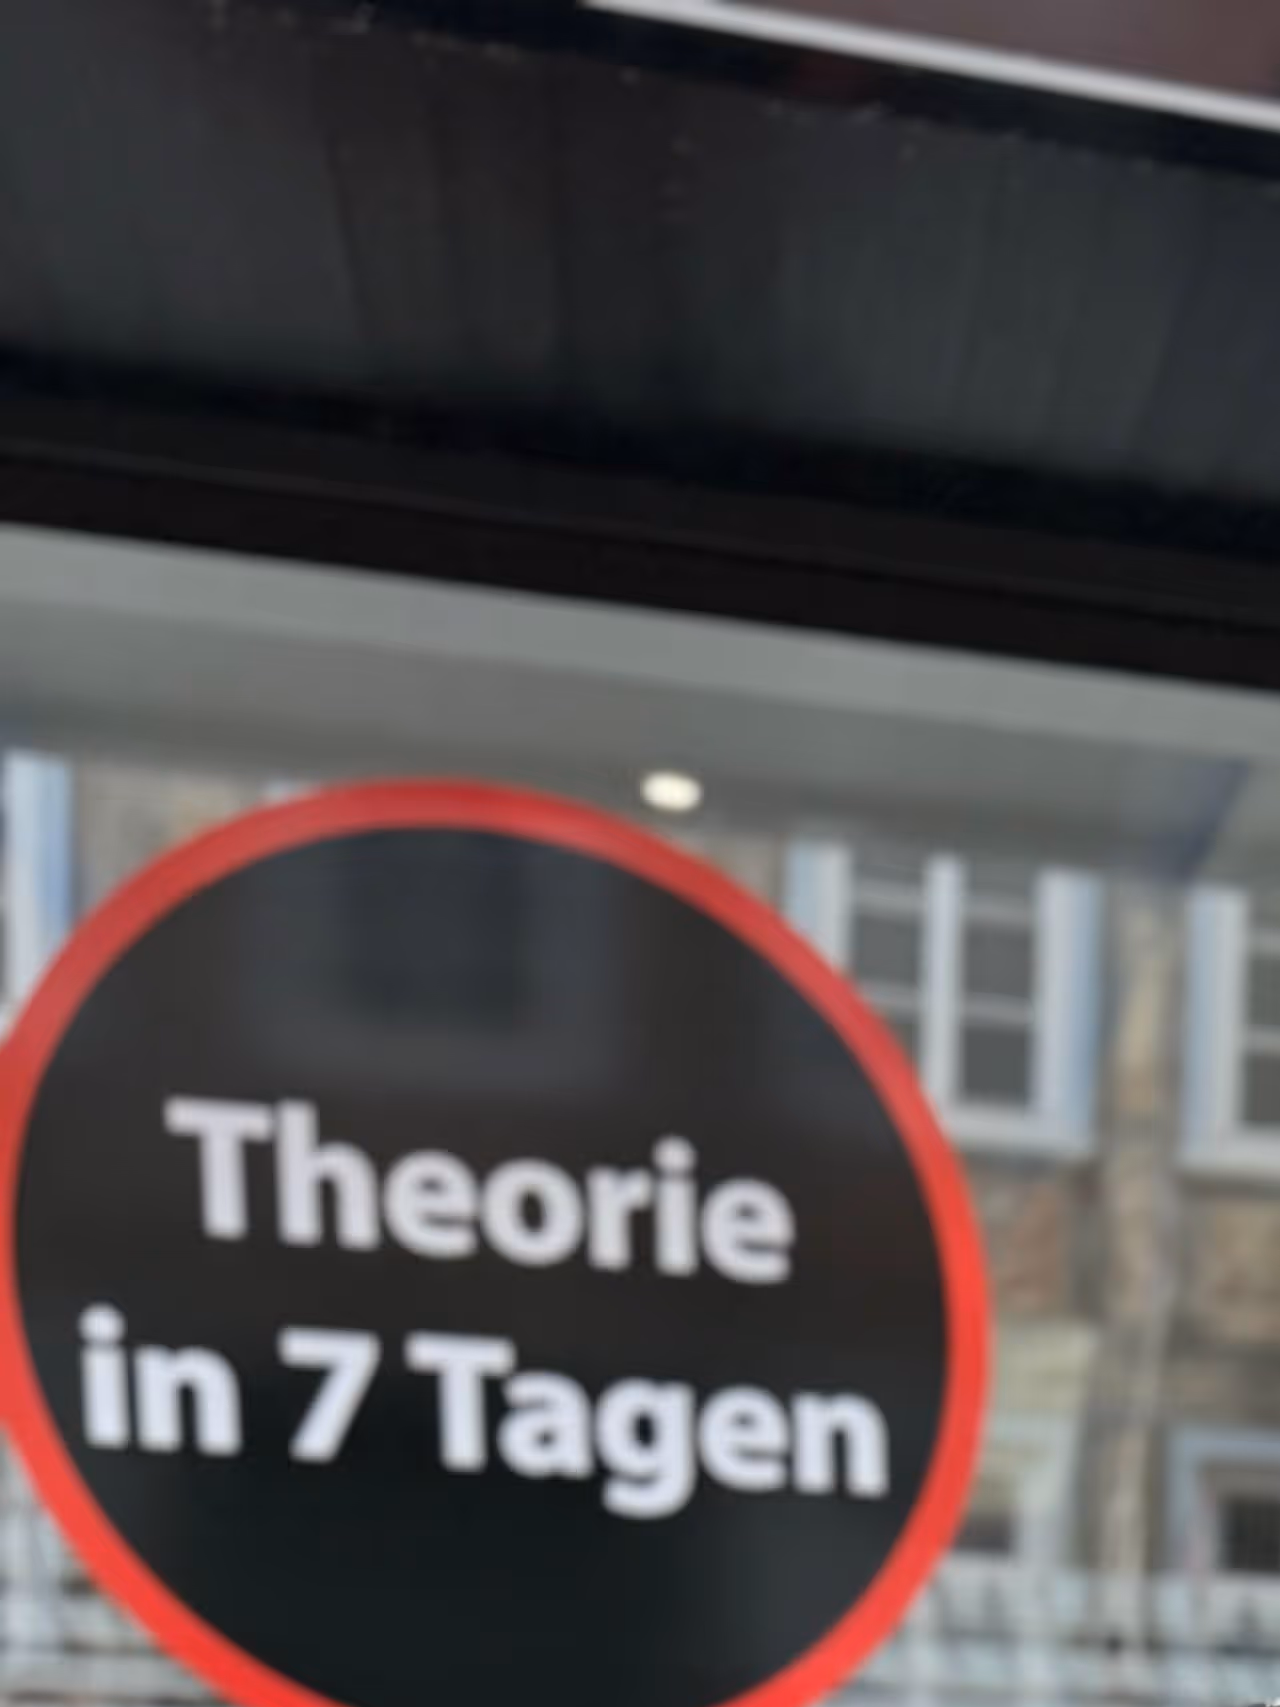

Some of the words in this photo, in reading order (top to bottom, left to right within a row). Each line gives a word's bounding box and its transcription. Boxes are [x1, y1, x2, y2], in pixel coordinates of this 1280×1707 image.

[165, 1098, 796, 1283] Theorie
[80, 1304, 240, 1455] in
[280, 1328, 380, 1460] 7
[406, 1333, 889, 1517] Tagen
